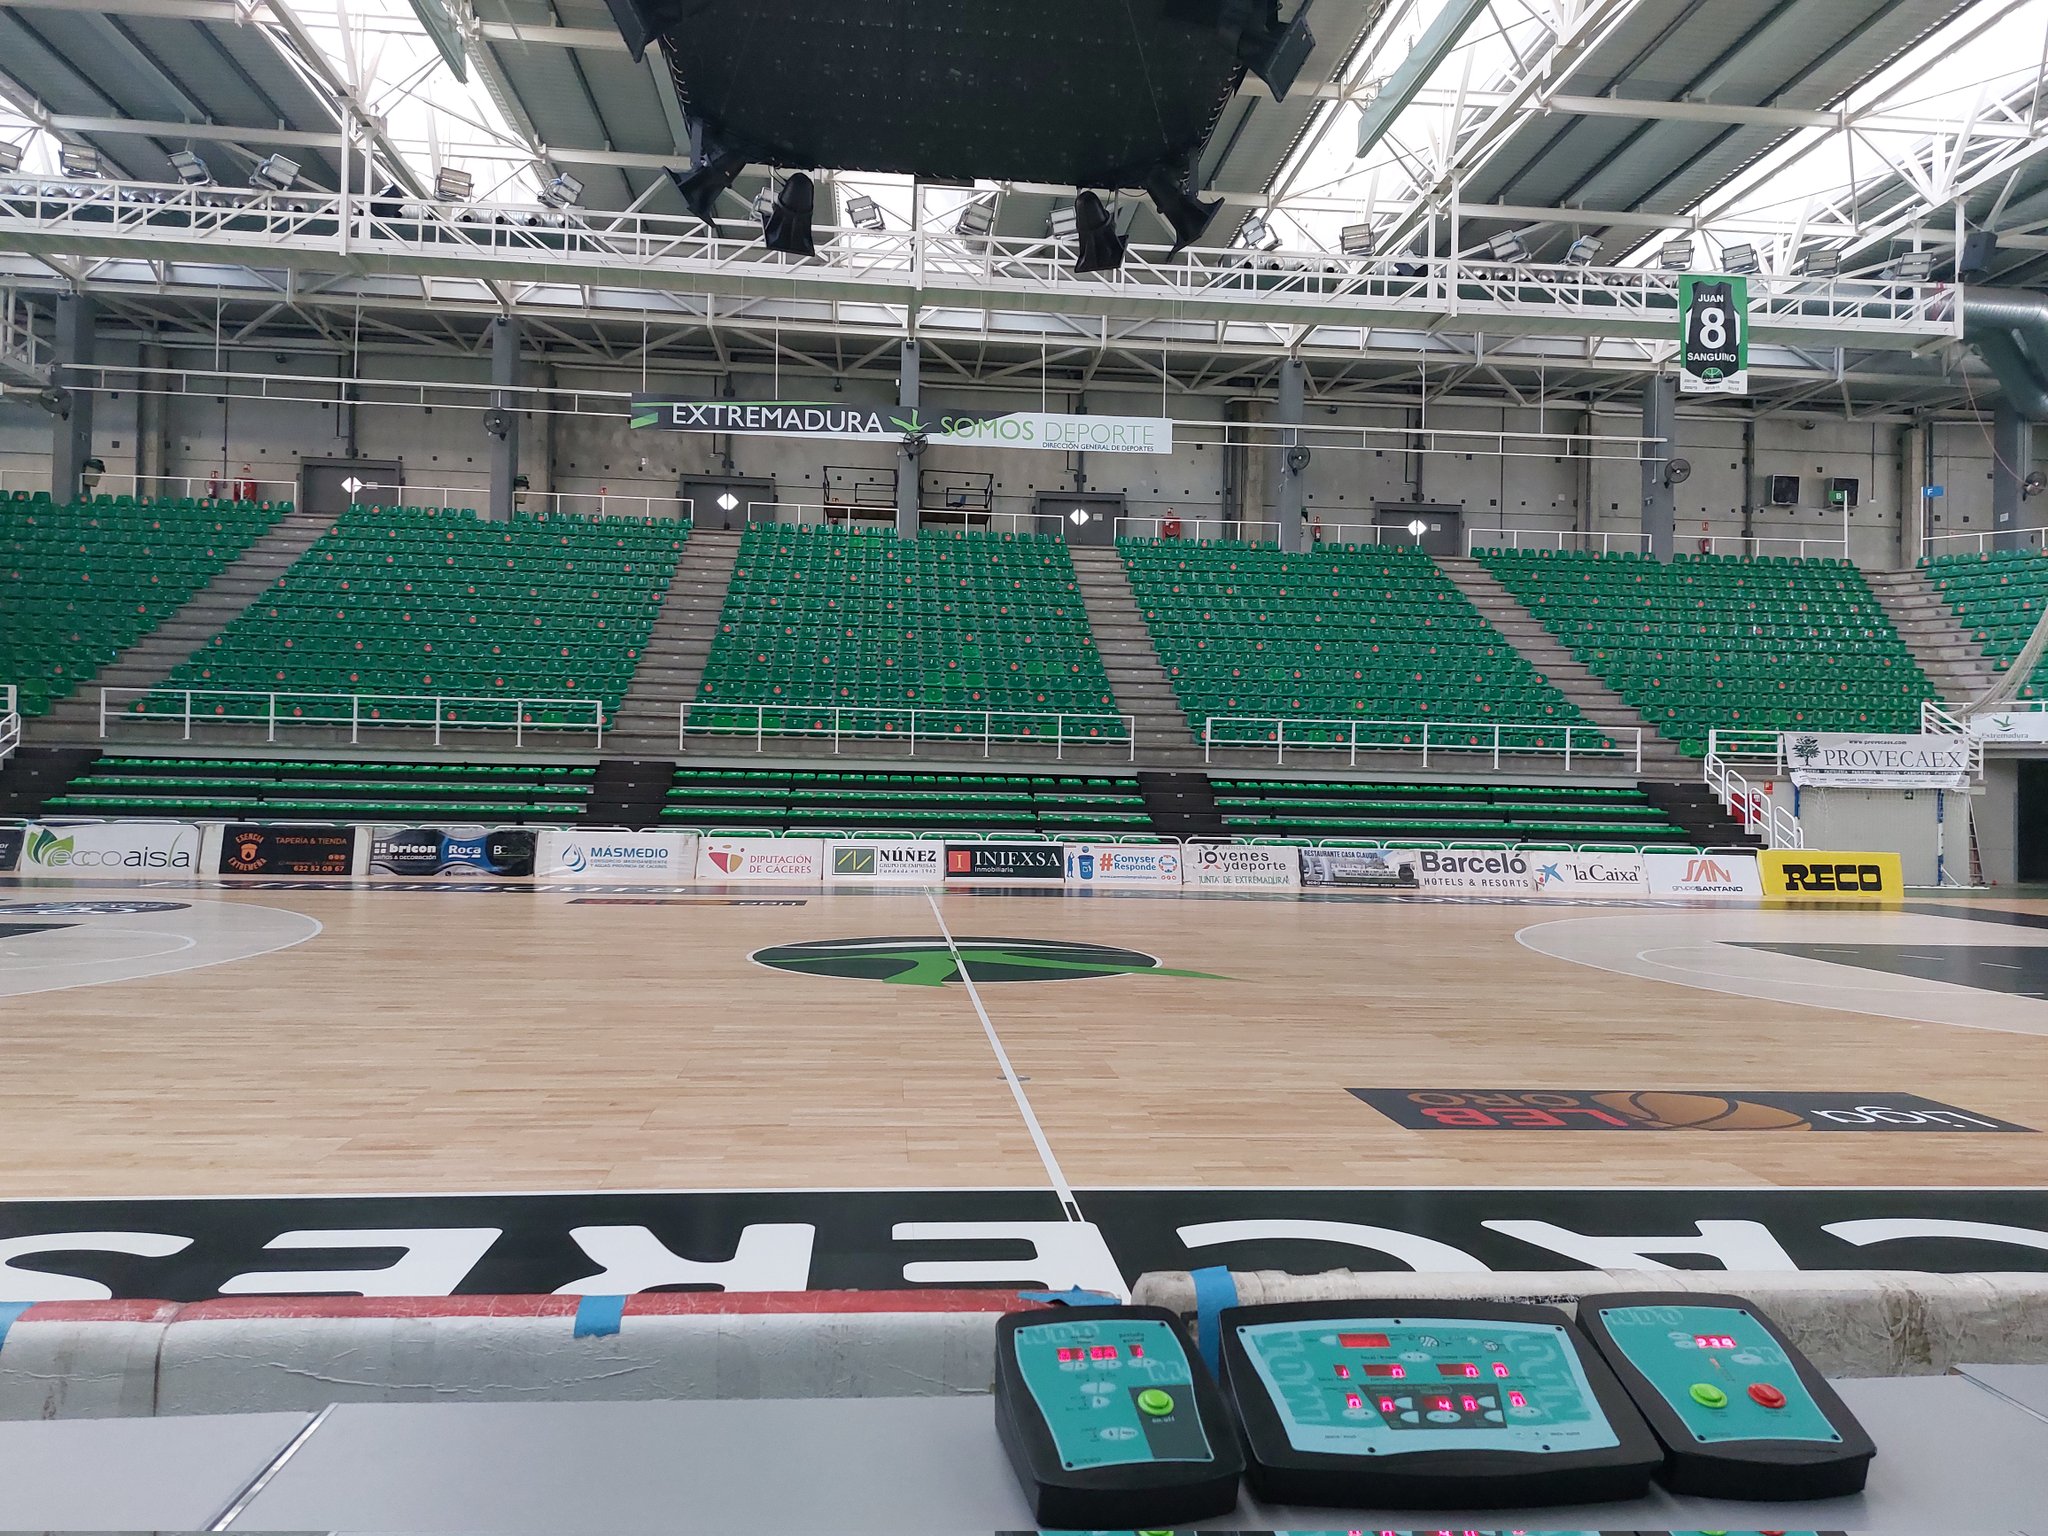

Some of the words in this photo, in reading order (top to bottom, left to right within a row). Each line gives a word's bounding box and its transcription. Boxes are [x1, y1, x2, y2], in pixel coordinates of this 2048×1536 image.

[1698, 294, 1724, 303] JUAN
[1700, 307, 1727, 349] 8
[672, 403, 884, 432] EXTREMADURA
[940, 416, 1034, 441] SOMOS
[1044, 421, 1155, 445] DEPORTE
[1121, 444, 1154, 452] DEPORTES
[1835, 492, 1842, 500] B
[1823, 749, 1965, 768] PROVECAEX
[236, 833, 265, 844] ESENCIA
[389, 844, 437, 854] bricon
[448, 845, 481, 855] Roca
[880, 847, 937, 862] NÚÑEZ
[1304, 850, 1340, 858] RESTAURANTE
[1342, 851, 1356, 859] CASA
[975, 851, 1061, 867] INIEXSA
[1420, 852, 1527, 874] Barceló
[749, 865, 761, 874] DE
[1114, 863, 1157, 871] Responde
[1199, 876, 1219, 884] JUNTA
[1223, 876, 1232, 884] DE
[1235, 876, 1288, 885] EXTREMADURA
[1424, 877, 1464, 887] HOTELS
[1482, 879, 1529, 888] RESORTS
[1782, 864, 1882, 891] RECO
